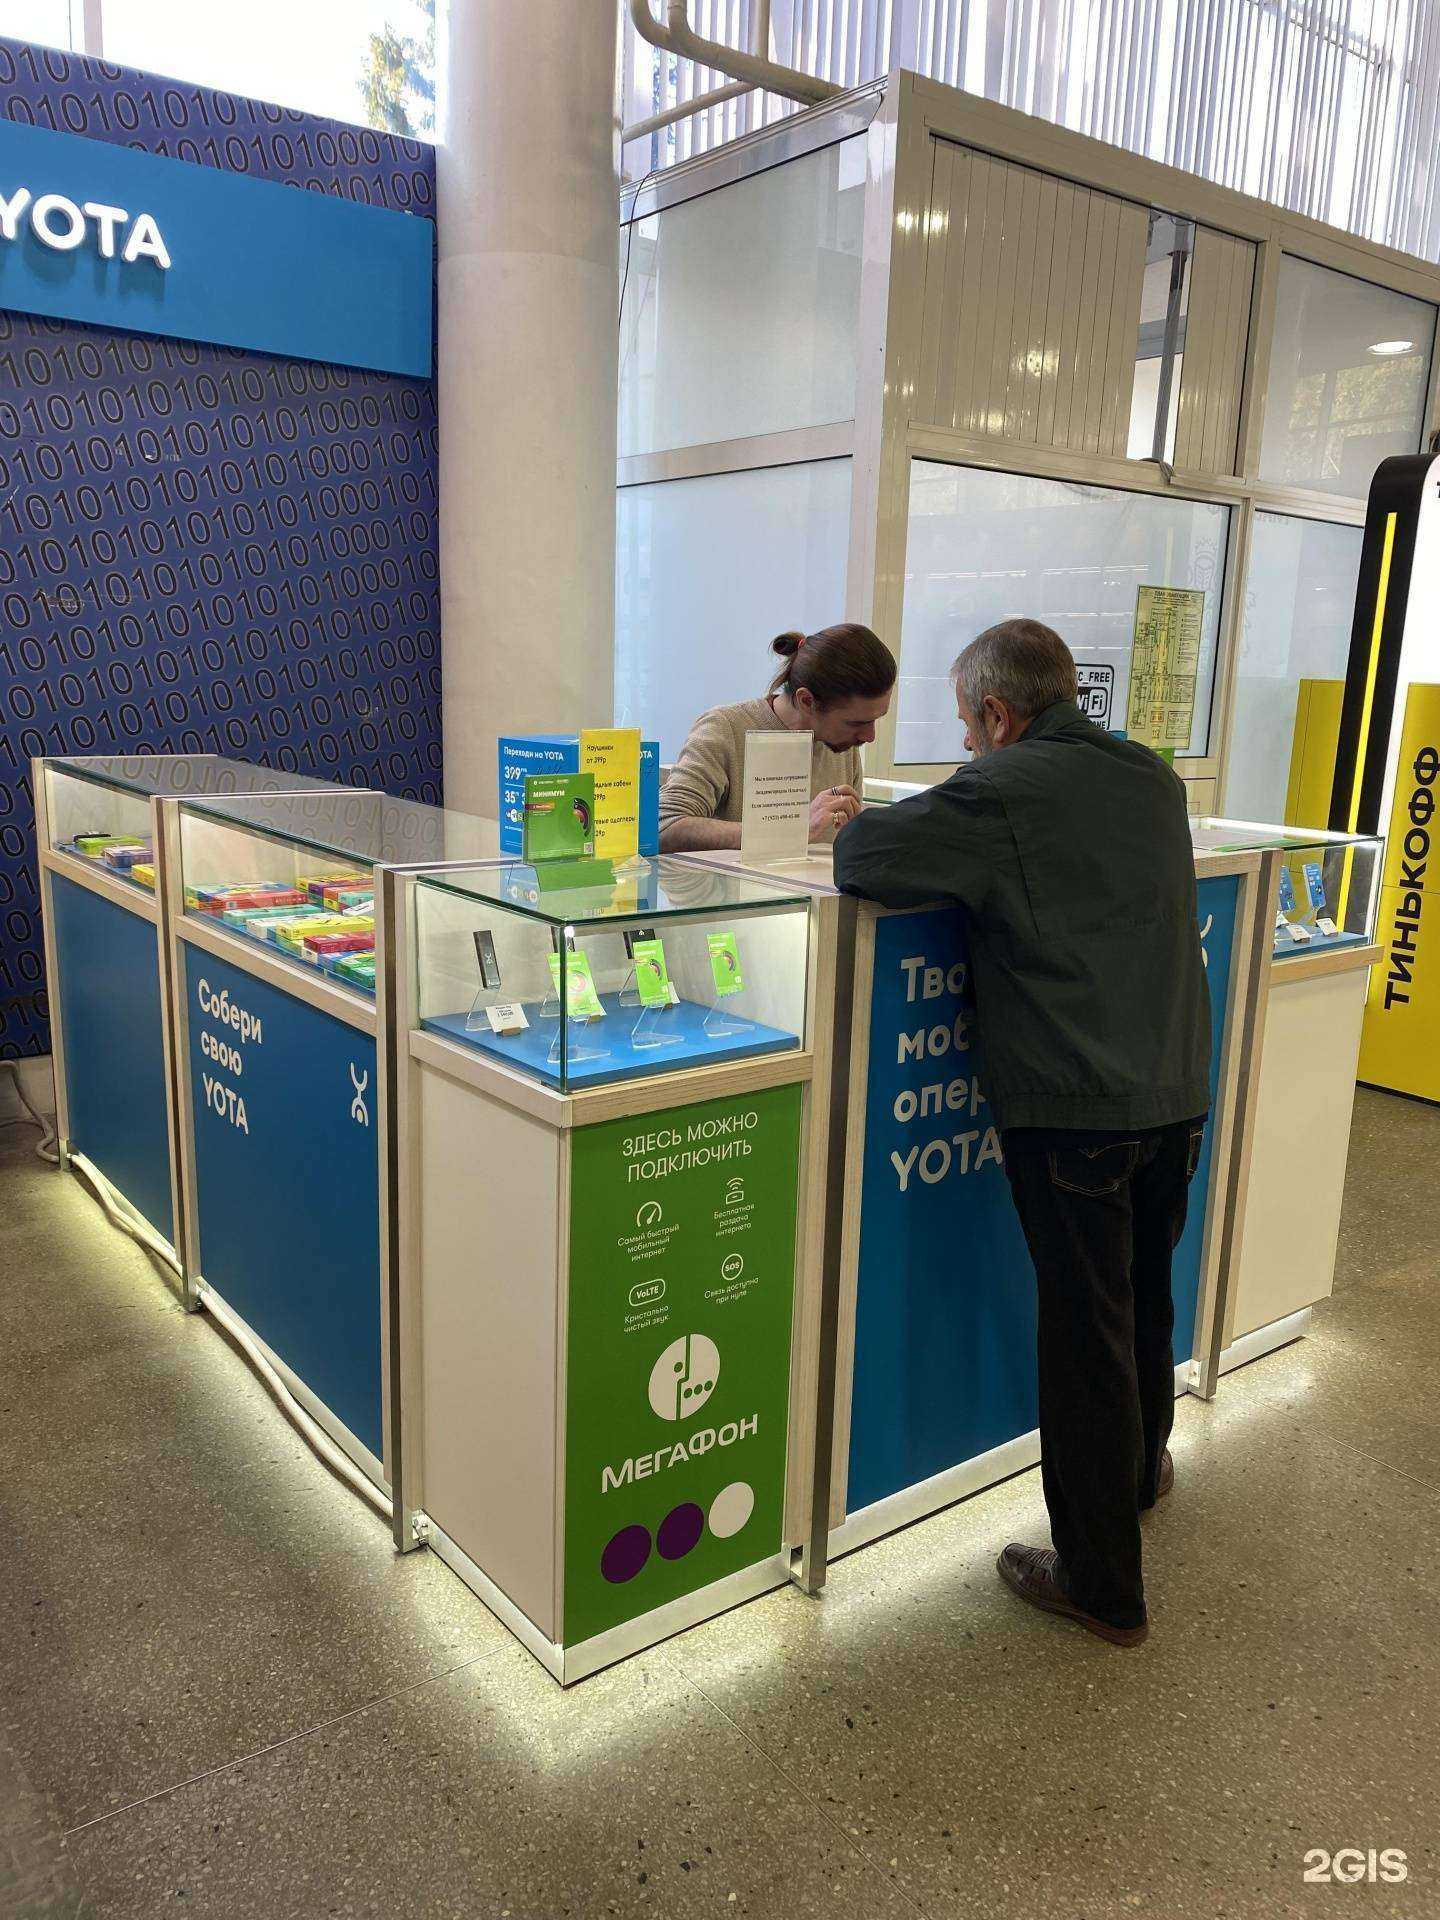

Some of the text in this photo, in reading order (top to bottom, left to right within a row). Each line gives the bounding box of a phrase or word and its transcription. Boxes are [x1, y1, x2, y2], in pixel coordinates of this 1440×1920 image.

[0, 187, 172, 270] YOTA
[1077, 671, 1111, 685] C_FREE
[544, 750, 564, 761] YOTA
[1384, 745, 1440, 1010] ТИНЬКОФФ
[198, 978, 263, 1044] Собери
[201, 1030, 243, 1076] свою
[202, 1072, 249, 1135] YOTA
[622, 1111, 758, 1157] ЗДЕСЬ МОЖНО
[627, 1139, 752, 1183] ПОДКЛЮЧИТЬ
[890, 1125, 1004, 1192] YOTA
[713, 1203, 755, 1220] Бесплатная
[719, 1214, 749, 1228] раздача
[617, 1223, 680, 1247] Самый быстрый
[715, 1222, 752, 1237] интернета
[627, 1236, 670, 1254] мобильный
[631, 1247, 666, 1262] интернет
[724, 1261, 740, 1272] SOS
[636, 1285, 660, 1299] VoLTE
[624, 1305, 669, 1324] Кристально
[623, 1318, 651, 1333] чистый
[601, 1413, 759, 1494] МЕГАФОН
